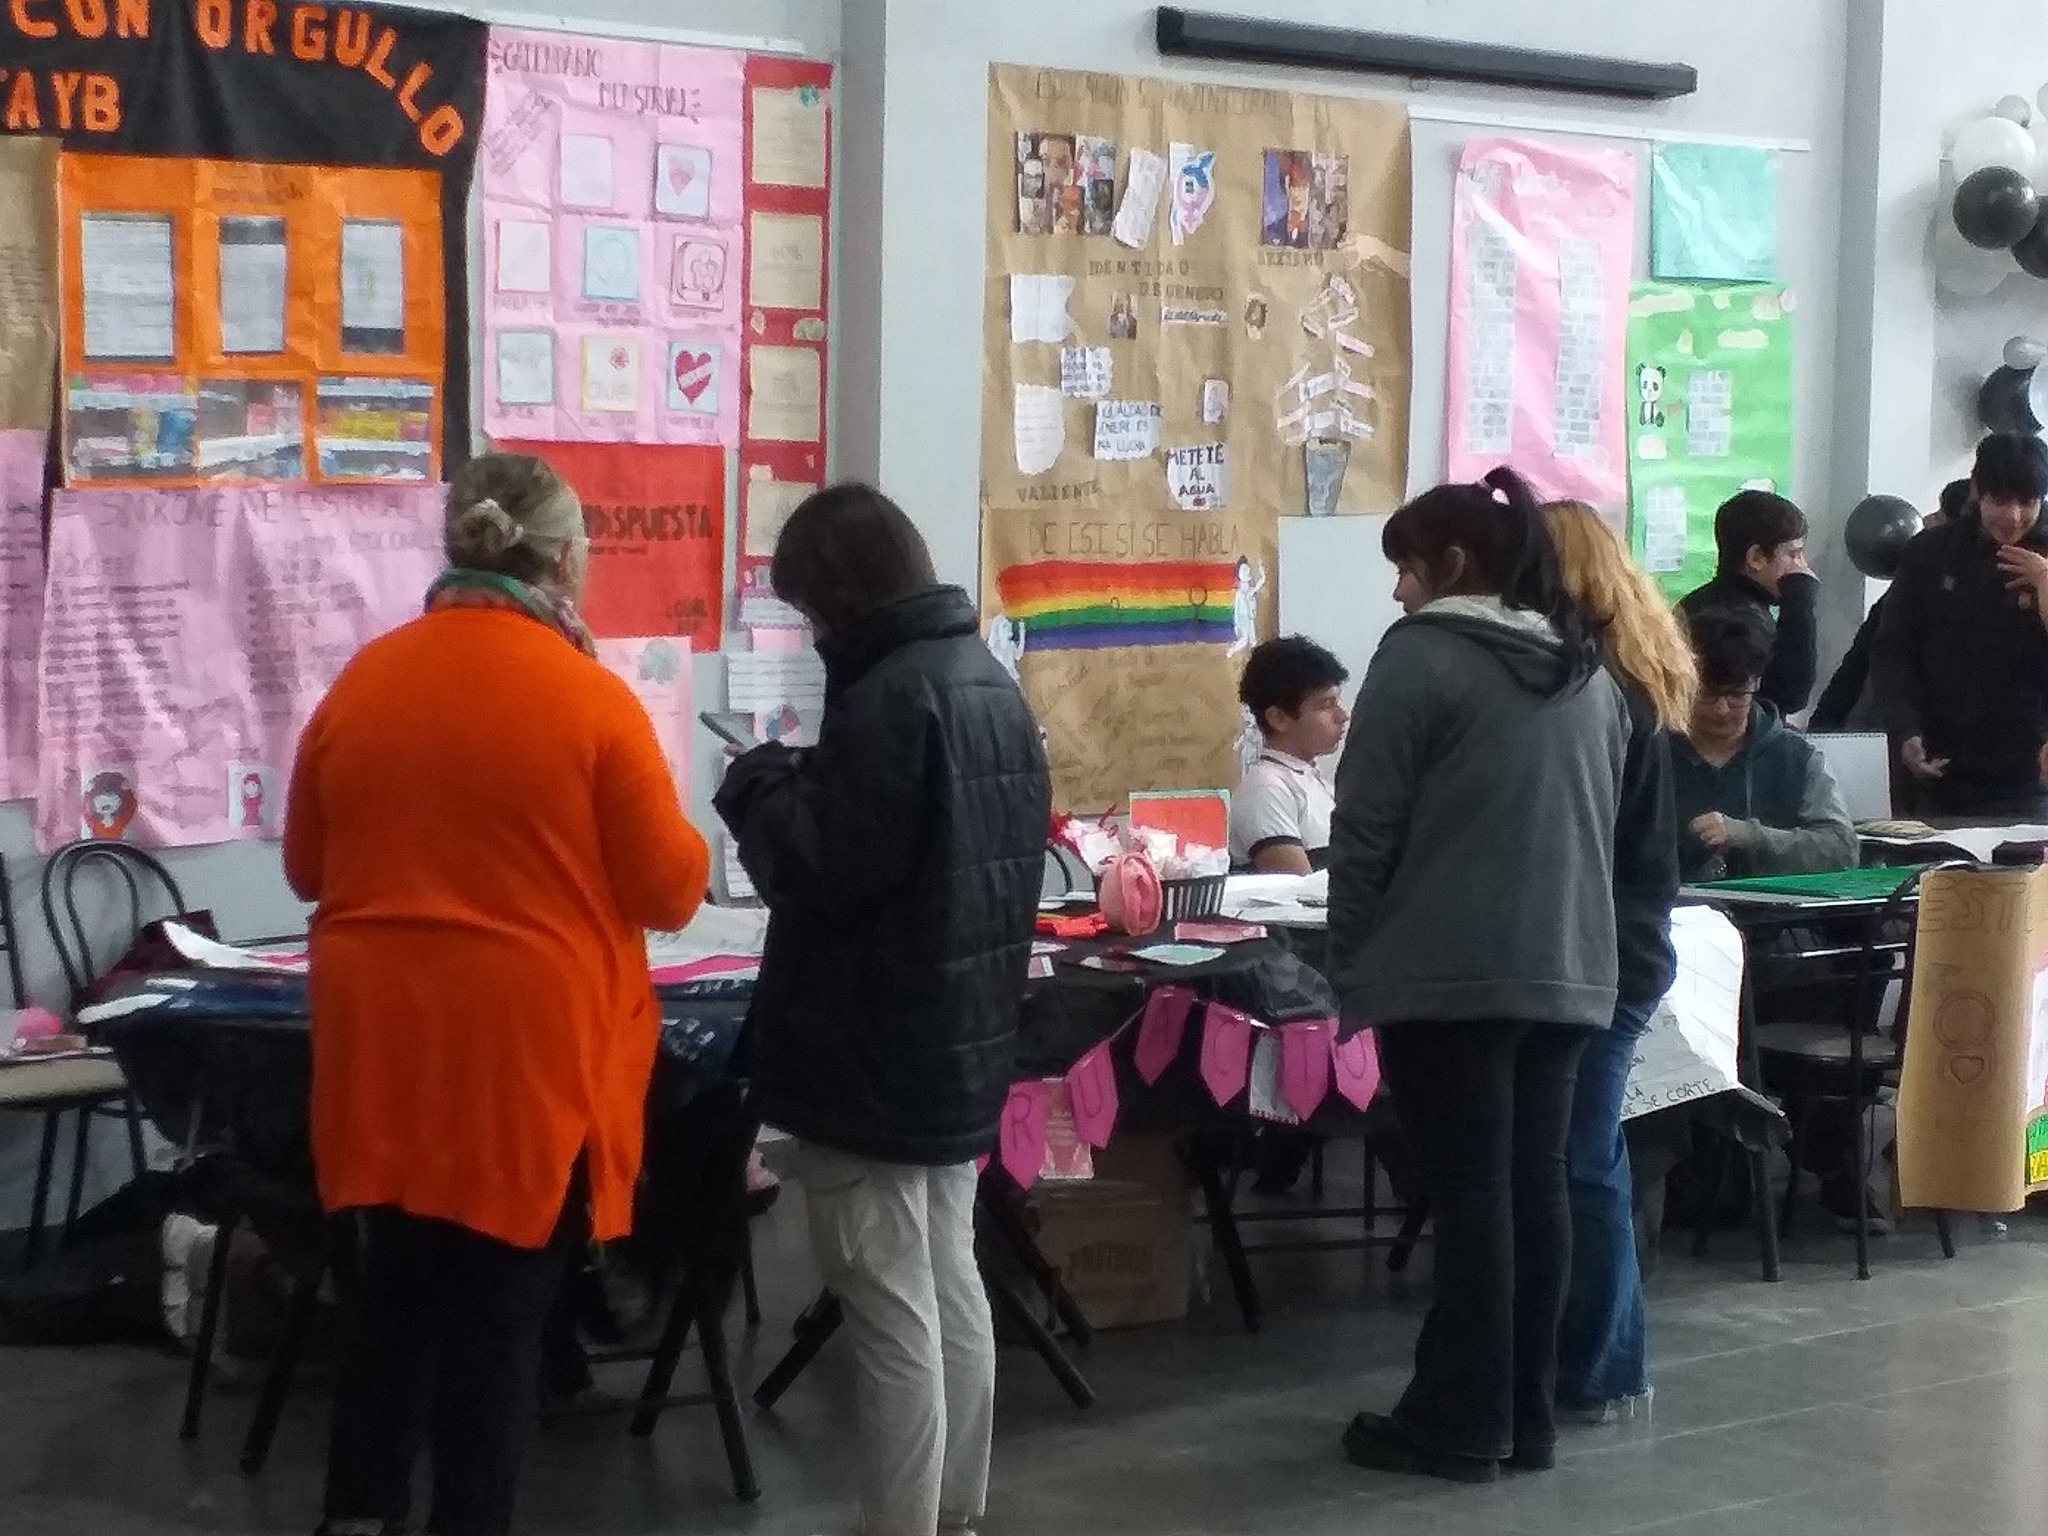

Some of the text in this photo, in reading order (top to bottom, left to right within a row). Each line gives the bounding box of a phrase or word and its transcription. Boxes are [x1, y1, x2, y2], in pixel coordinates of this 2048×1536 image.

[12, 0, 150, 38] CON
[196, 0, 464, 157] ORGULLO
[1666, 1077, 1716, 1103] CORTE
